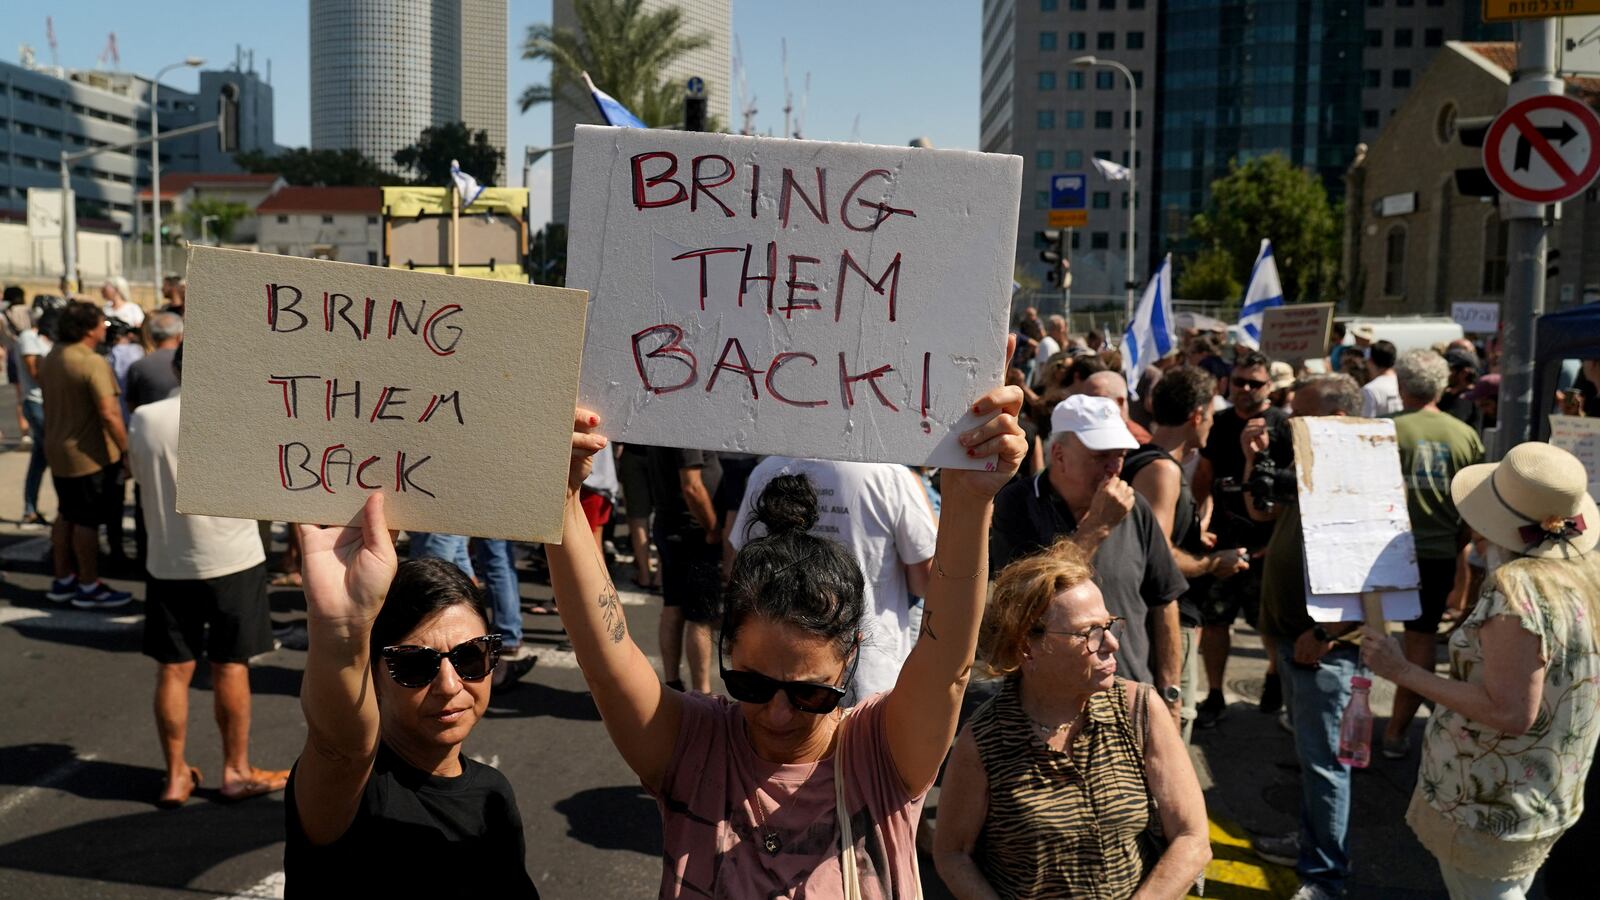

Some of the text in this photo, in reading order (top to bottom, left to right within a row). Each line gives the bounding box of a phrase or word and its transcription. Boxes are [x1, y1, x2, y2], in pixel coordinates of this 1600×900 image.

[630, 151, 917, 232] BRING
[266, 283, 464, 356] BRING
[671, 240, 902, 322] THEM
[268, 374, 464, 425] THEM
[631, 323, 932, 434] BACK!
[278, 441, 436, 498] BACK
